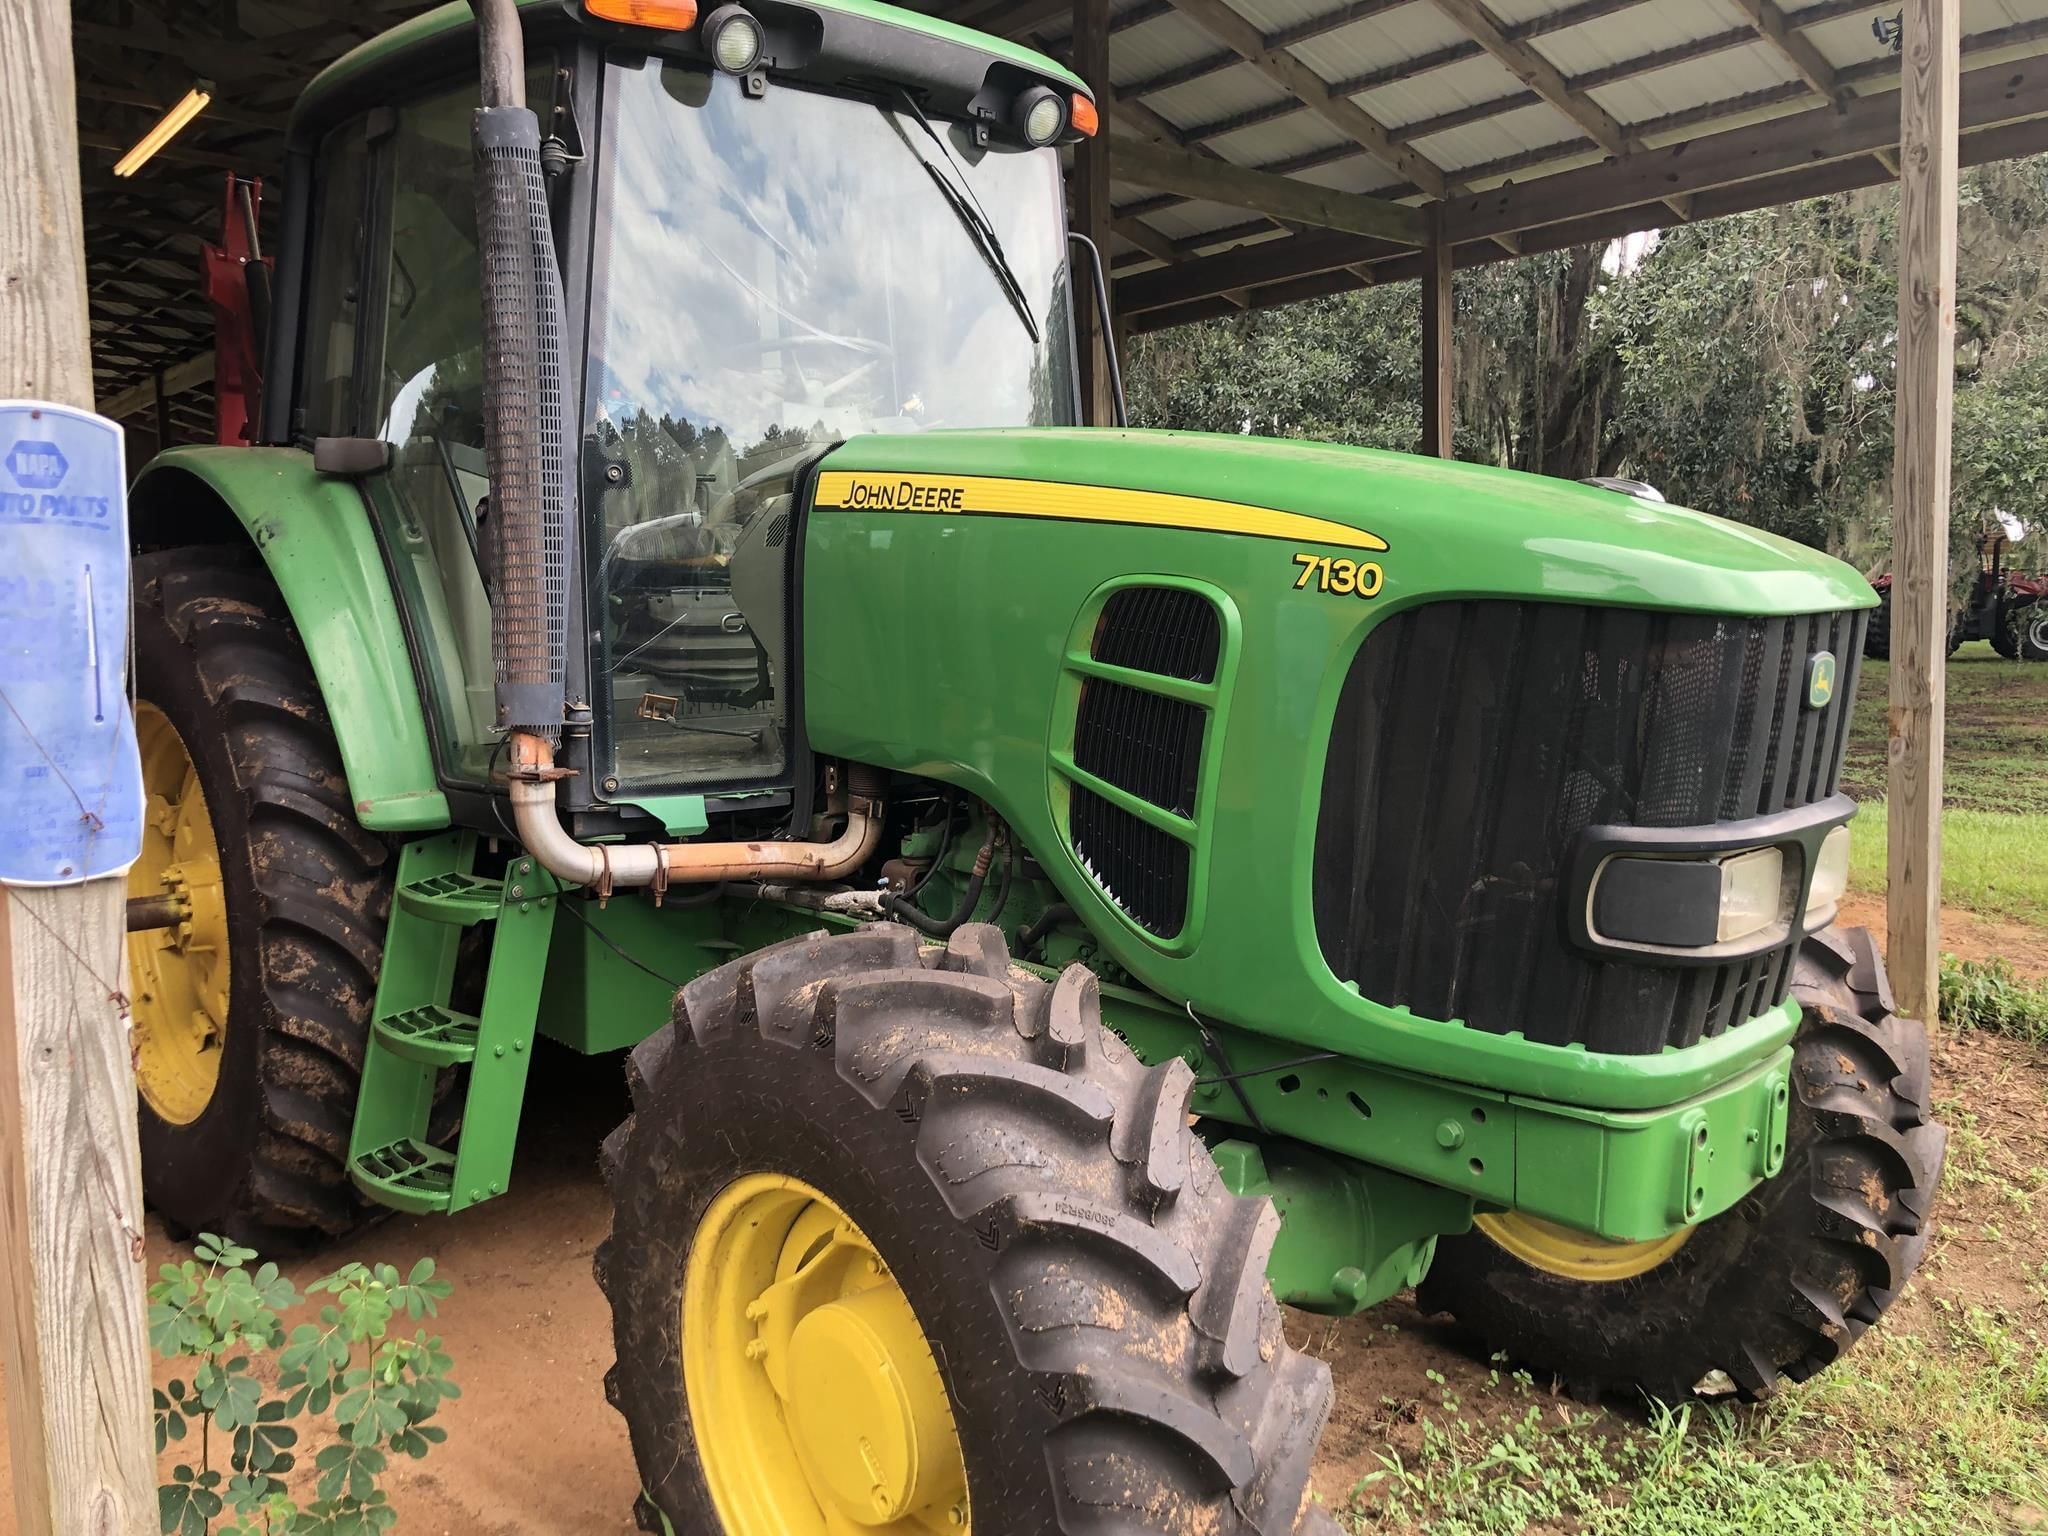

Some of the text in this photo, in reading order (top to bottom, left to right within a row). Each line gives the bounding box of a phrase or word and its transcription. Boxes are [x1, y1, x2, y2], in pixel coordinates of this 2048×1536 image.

[40, 494, 109, 518] PARTS
[843, 480, 964, 508] JOHN DEERE
[1292, 553, 1385, 600] 7130
